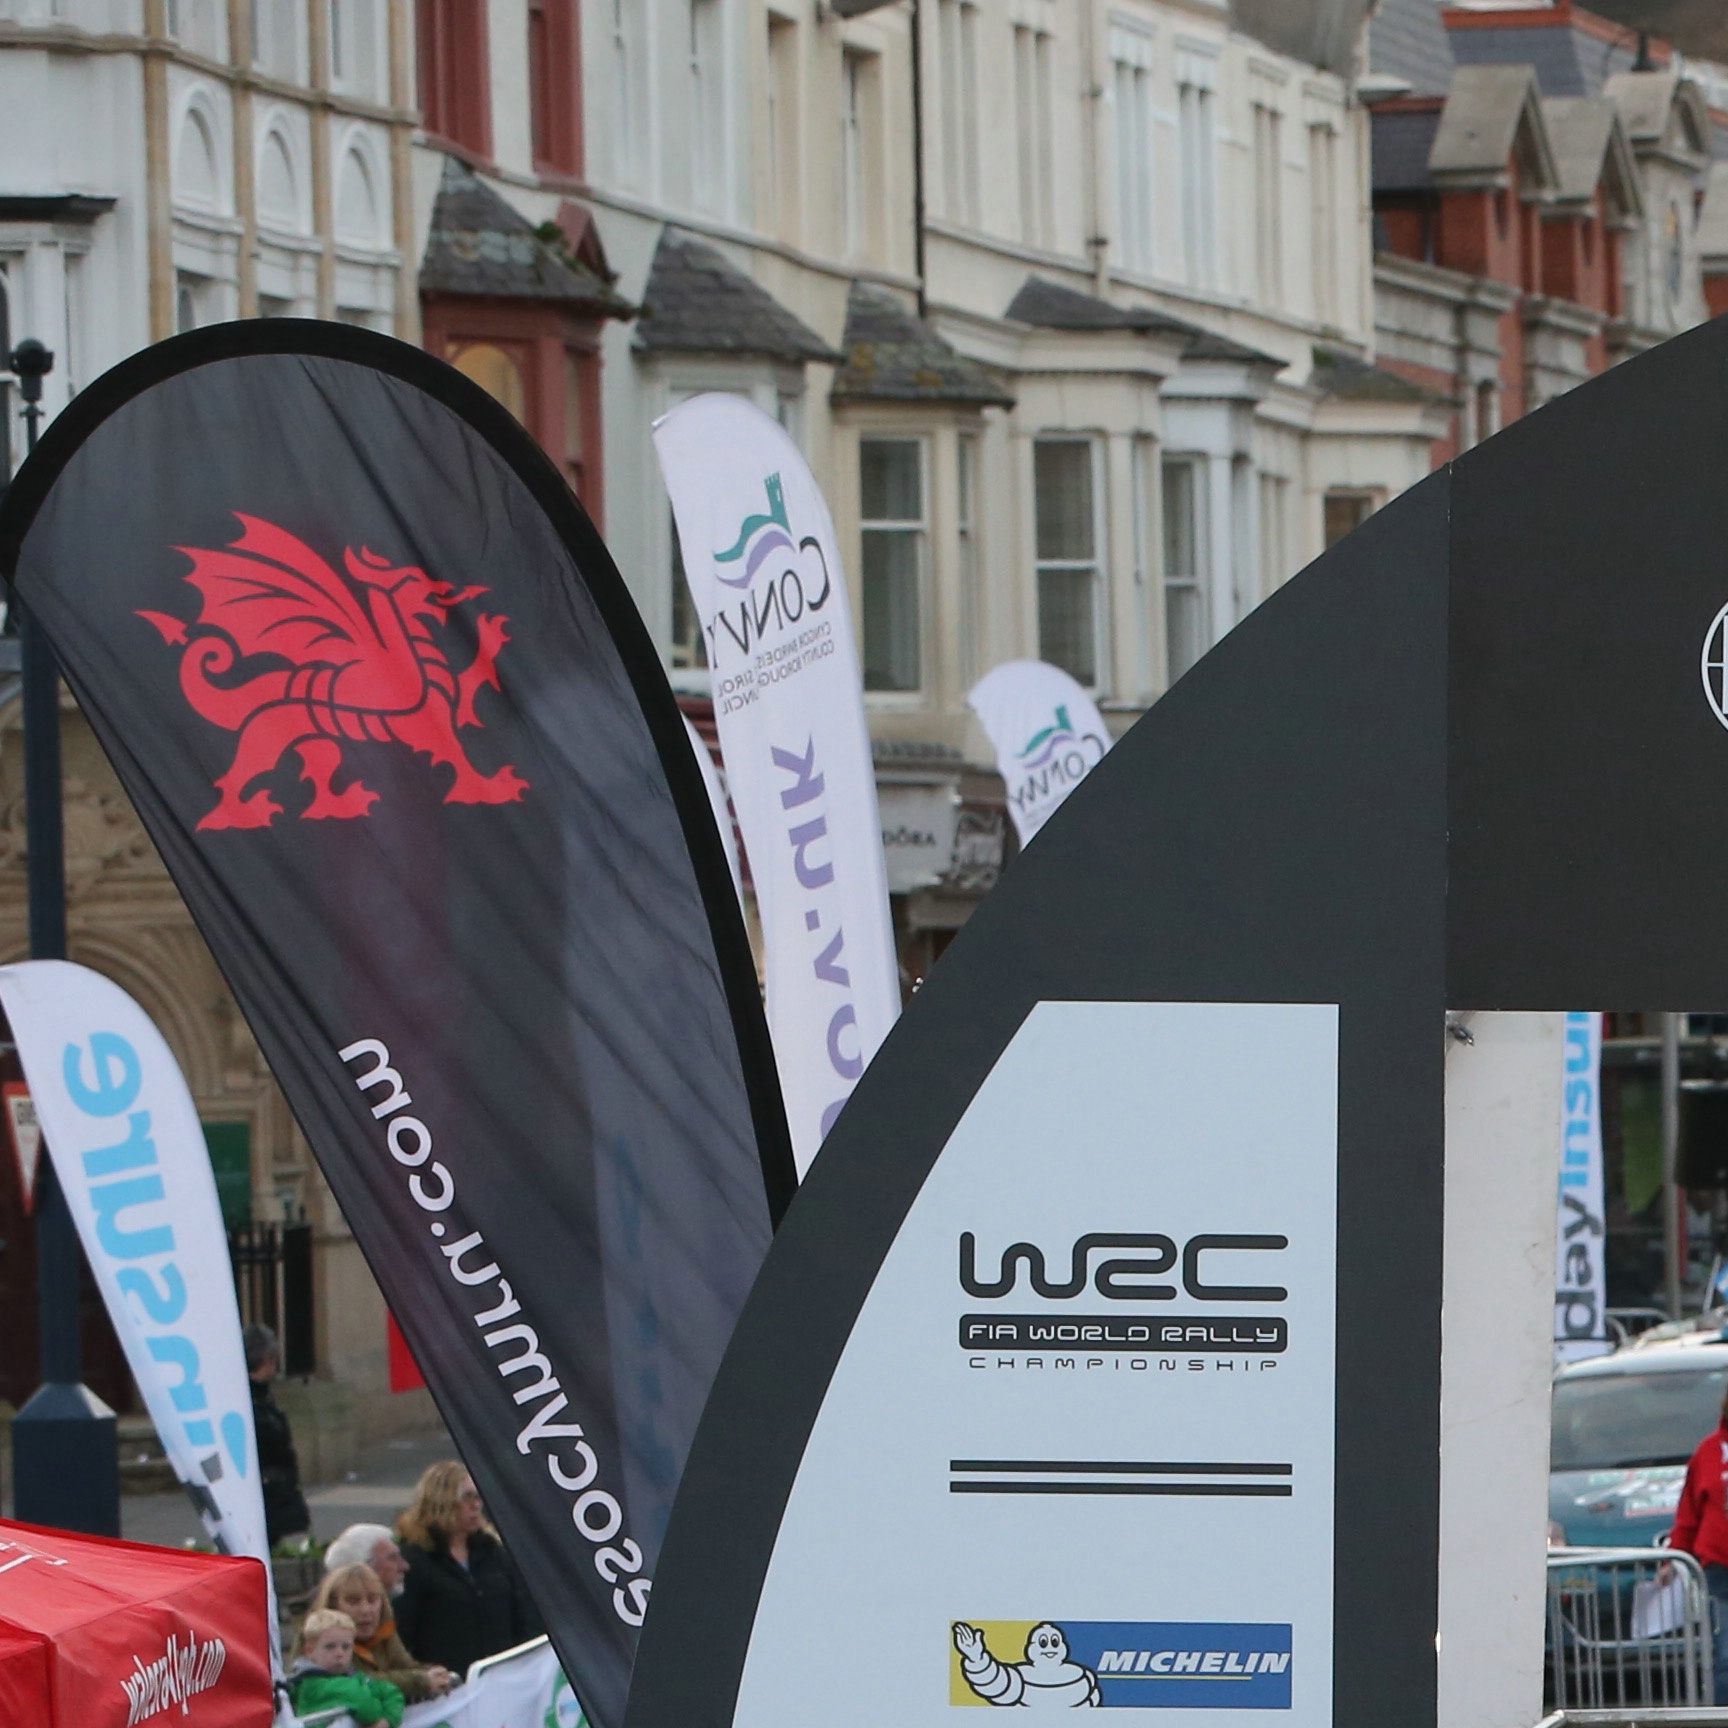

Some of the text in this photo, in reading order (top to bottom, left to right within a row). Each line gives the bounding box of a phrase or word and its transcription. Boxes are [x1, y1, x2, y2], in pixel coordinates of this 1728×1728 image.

[960, 1231, 1289, 1301] WRC
[968, 1324, 1278, 1344] FIA WORLD RALLY
[968, 1356, 1278, 1372] CHAMPIONSHIP
[1097, 1650, 1290, 1675] MICHELIN
